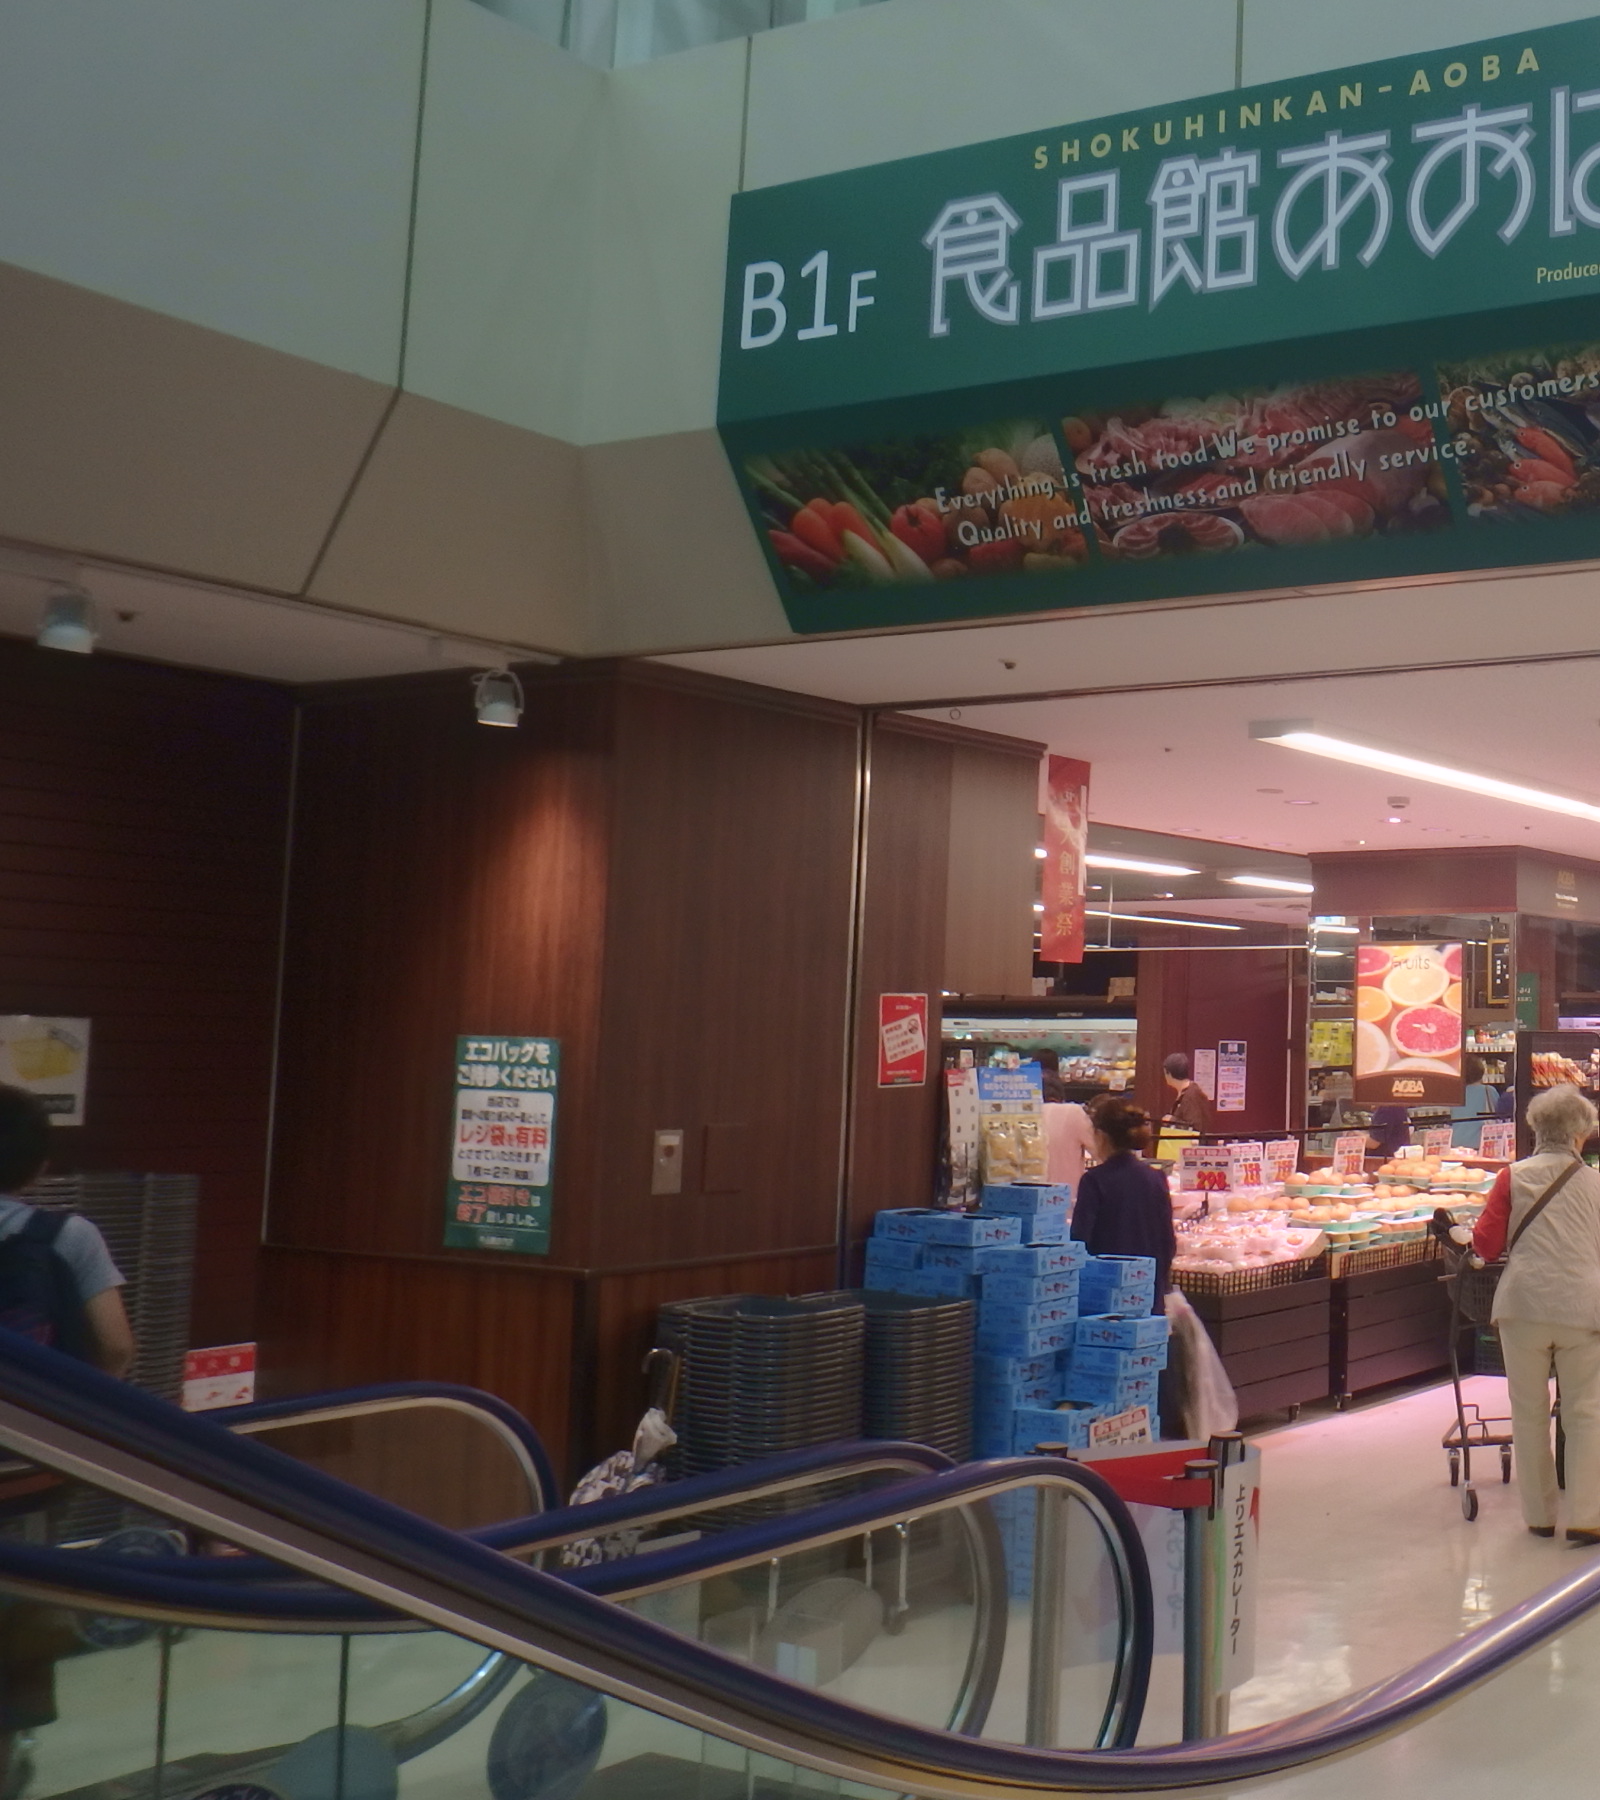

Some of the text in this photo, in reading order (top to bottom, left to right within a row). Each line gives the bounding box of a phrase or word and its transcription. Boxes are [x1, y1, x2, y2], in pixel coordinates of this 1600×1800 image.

[1033, 47, 1541, 170] SHOKUHINKAN-AOBA
[741, 250, 877, 350] B1F
[934, 472, 1055, 514] Everything
[1062, 466, 1080, 490] is
[1089, 453, 1148, 483] fresh
[1267, 420, 1360, 461] promise
[1371, 406, 1397, 430] to
[1409, 399, 1453, 424] our
[957, 516, 1044, 549] Quality
[1053, 502, 1092, 532] and
[1268, 446, 1365, 492] friendly
[1378, 437, 1477, 472] service.
[1391, 955, 1430, 970] Fruits
[465, 1040, 550, 1064] エコバッグを
[456, 1064, 557, 1088] ご持参ください
[1391, 1080, 1425, 1093] AOBA
[459, 1124, 548, 1149] レジ袋を有料
[1196, 1171, 1228, 1190] 298
[1230, 1484, 1247, 1656] 上りエスカレーター
